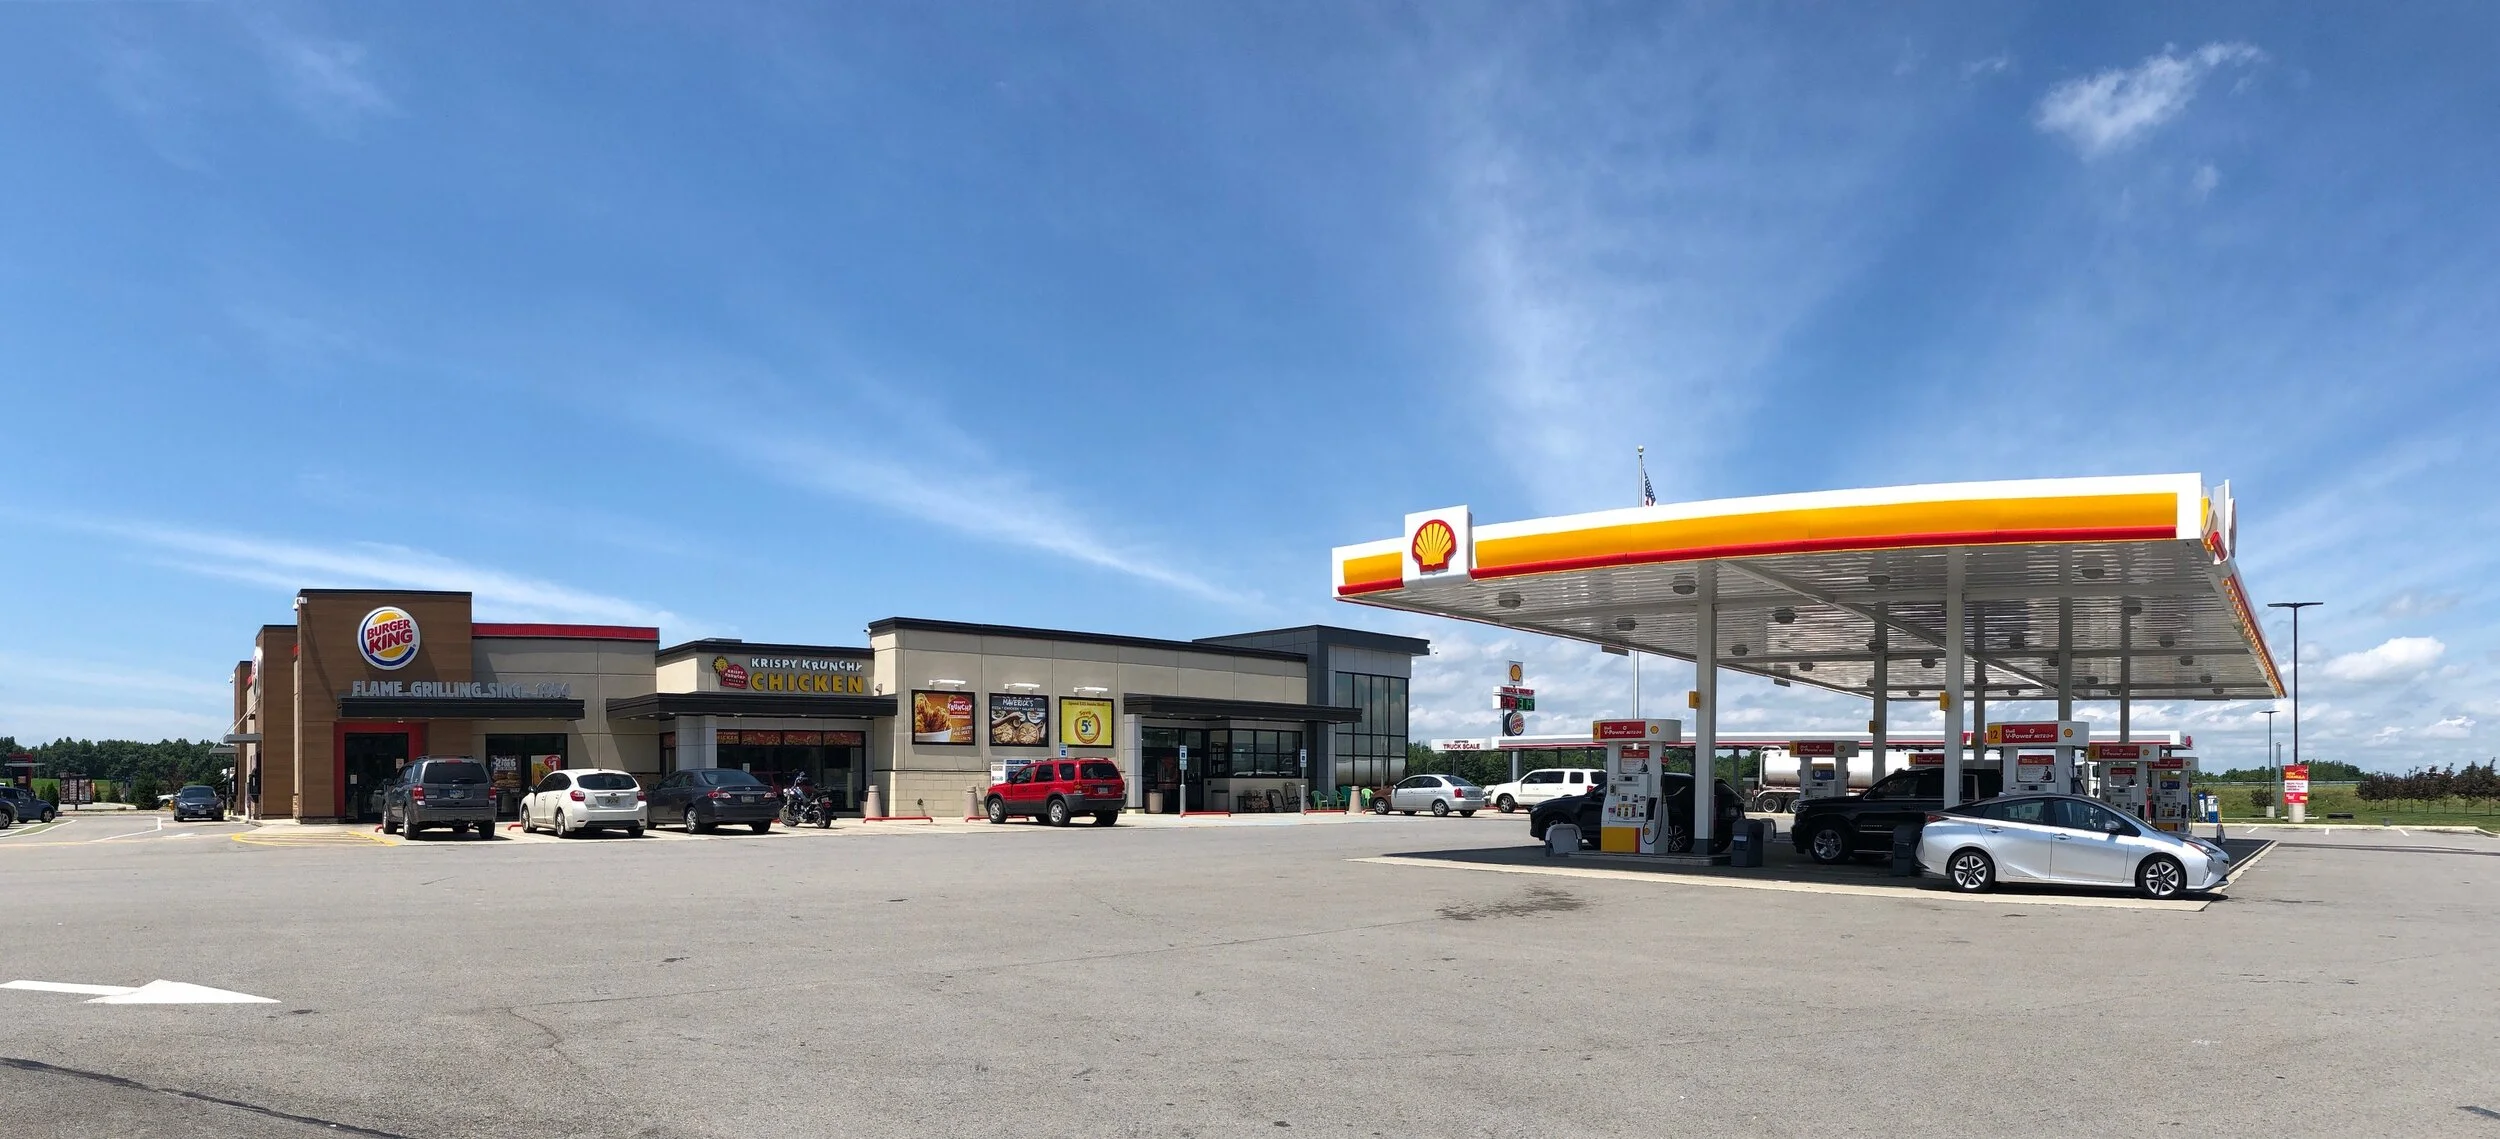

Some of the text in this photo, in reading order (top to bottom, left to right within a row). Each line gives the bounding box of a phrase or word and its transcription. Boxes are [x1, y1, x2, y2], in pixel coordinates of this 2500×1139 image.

[367, 619, 411, 640] BURGER
[369, 629, 413, 655] KING
[751, 658, 863, 672] KRISPY KRUNCHY
[352, 681, 403, 697] FLAME
[410, 682, 482, 698] GRILLING
[487, 682, 529, 698] SINC
[751, 672, 864, 693] CHICKEN
[1990, 730, 1998, 739] 12
